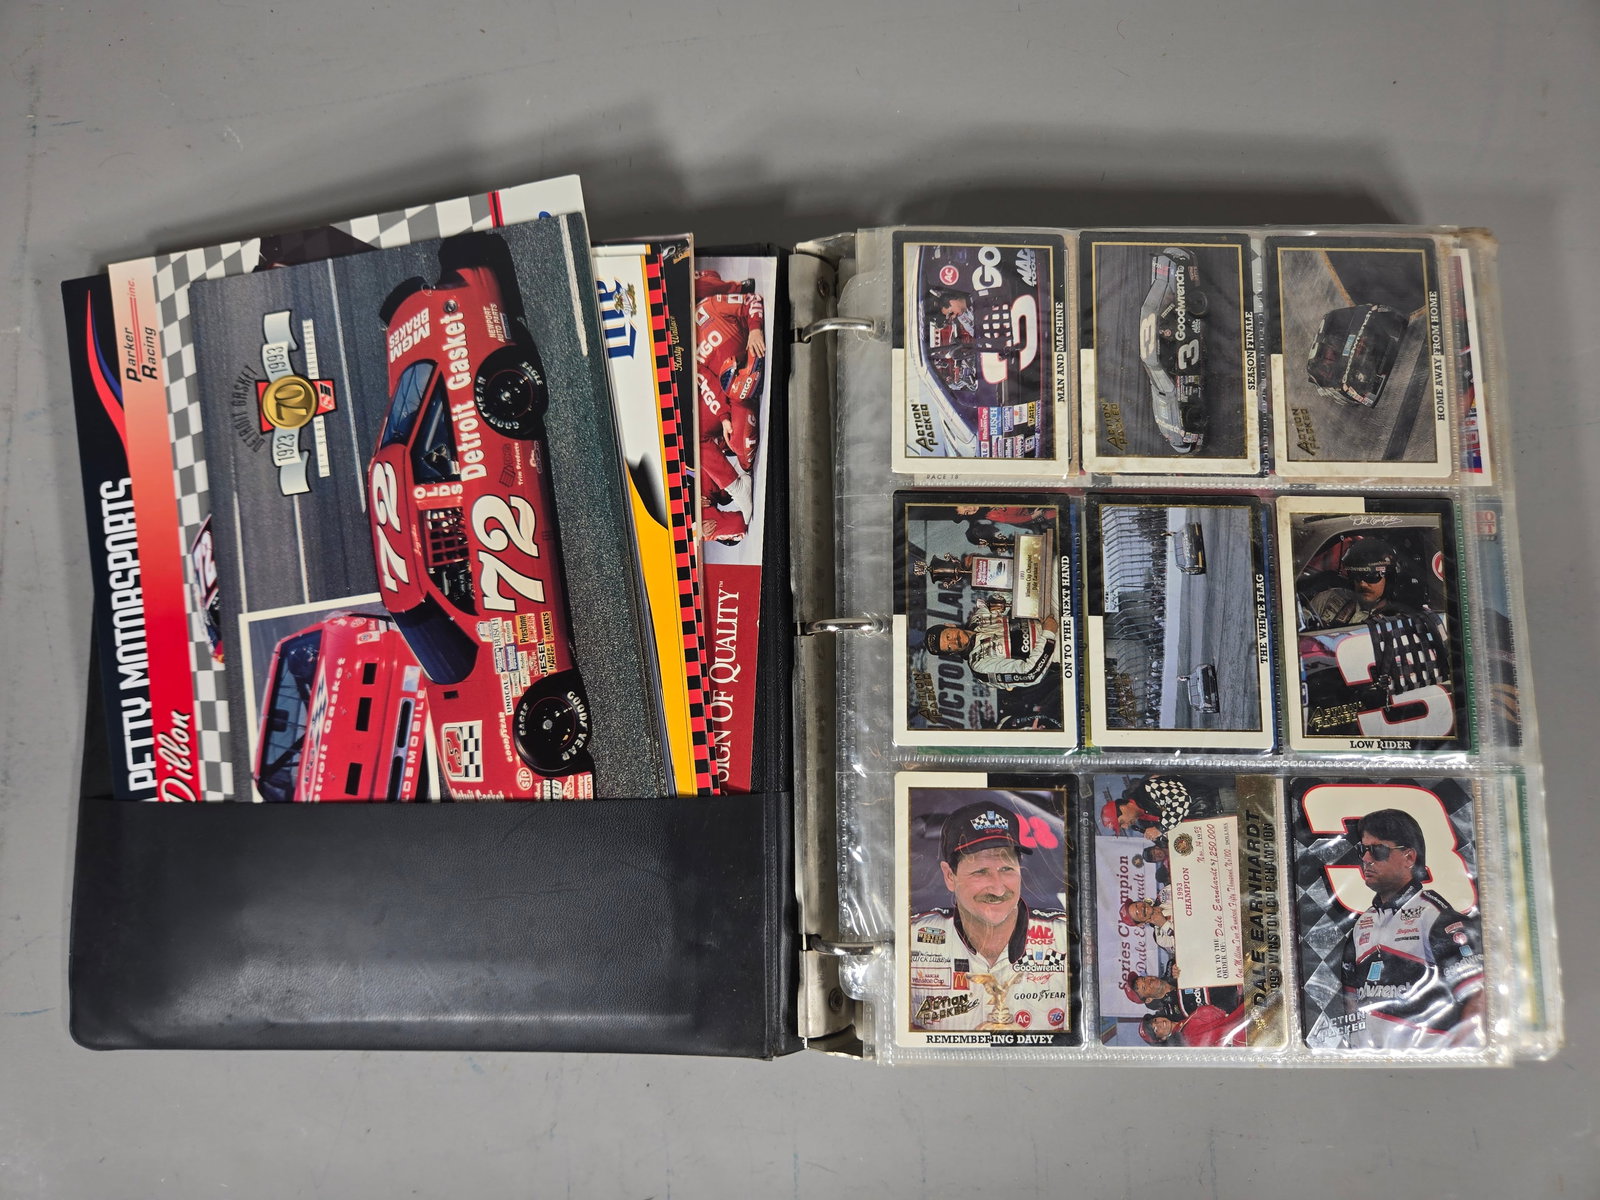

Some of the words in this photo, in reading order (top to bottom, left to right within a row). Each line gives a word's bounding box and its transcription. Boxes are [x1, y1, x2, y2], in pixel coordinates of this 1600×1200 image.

[943, 269, 954, 283] AC
[1015, 248, 1031, 287] MAC
[490, 303, 501, 324] PARTS
[1174, 269, 1186, 341] Goodwrench
[1429, 291, 1439, 322] HOME
[388, 307, 430, 350] BRAKES
[483, 306, 497, 338] NEWPORT
[494, 324, 506, 343] AUTO
[1055, 302, 1064, 352] MACHINE
[1140, 312, 1156, 360] 3
[1245, 311, 1254, 349] FINALE
[126, 327, 142, 382] Parker
[142, 326, 158, 380] Racing
[390, 322, 431, 363] MGM
[440, 312, 471, 391] Gasket
[1178, 339, 1200, 369] 3
[1431, 325, 1441, 355] FROM
[266, 346, 288, 374] 1993
[672, 346, 685, 372] Rusty
[1055, 354, 1065, 376] AND
[1246, 350, 1256, 390] SEASON
[1434, 358, 1443, 387] AWAY
[231, 365, 257, 407] GASKET
[274, 383, 308, 421] 70
[1056, 378, 1066, 403] MAN
[990, 407, 998, 435] BUSCH
[1435, 389, 1446, 421] HOME
[231, 413, 266, 453] DETROIT
[911, 404, 934, 452] ACTION
[920, 404, 939, 446] PACKED
[1102, 403, 1123, 451] ACTION
[1111, 403, 1128, 444] PACKED
[1292, 408, 1315, 456] ACTION
[1300, 408, 1320, 450] PACKED
[276, 434, 296, 461] 1923
[452, 400, 488, 482] Detroit
[371, 462, 410, 593] 72
[471, 494, 546, 612] 72
[99, 478, 151, 690] MOTORSPORTS
[1061, 556, 1070, 586] HAND
[1062, 588, 1070, 617] NEXT
[1256, 574, 1265, 603] FLAG
[491, 618, 502, 647] BUSCH
[519, 615, 530, 643] Prestone
[1062, 620, 1071, 642] THE
[1258, 604, 1267, 640] WHITE
[538, 638, 549, 675] JESEL
[1063, 644, 1072, 659] TO
[1259, 643, 1268, 664] THE
[1064, 661, 1073, 679] ON
[322, 657, 346, 735] Gasket
[503, 680, 513, 713] UNOCAL
[912, 672, 937, 724] ACTION
[120, 697, 159, 792] PETTY
[157, 710, 197, 802] Dillon
[1350, 741, 1378, 750] LOW
[1380, 741, 1412, 750] RIDER
[1263, 823, 1276, 882] CHAMPION
[1176, 882, 1184, 901] 1993
[1182, 867, 1193, 916] CHAMPION
[1210, 867, 1222, 911] Earnhardt
[1245, 809, 1265, 942] EARNHARDT
[1264, 886, 1277, 908] CUP
[1026, 925, 1054, 940] MAC
[1026, 938, 1055, 946] TOOLS
[1214, 915, 1224, 937] Dale
[1265, 912, 1280, 964] WINSTON
[1012, 962, 1065, 974] Goodwrench
[1117, 941, 1131, 990] Series
[1135, 941, 1148, 973] Dale
[1215, 954, 1221, 963] TO
[1221, 955, 1229, 979] ORDER
[1026, 973, 1054, 984] Racing
[1251, 949, 1268, 1008] DALE
[1269, 968, 1282, 994] 1993
[916, 994, 968, 1019] ACTION
[1013, 989, 1067, 1002] GOODYEAR
[923, 1004, 968, 1025] PACKED
[1018, 1015, 1031, 1025] AC
[1314, 1010, 1366, 1038] ACTION
[926, 1034, 1014, 1044] REMEMBERING
[1016, 1033, 1055, 1044] DAVEY
